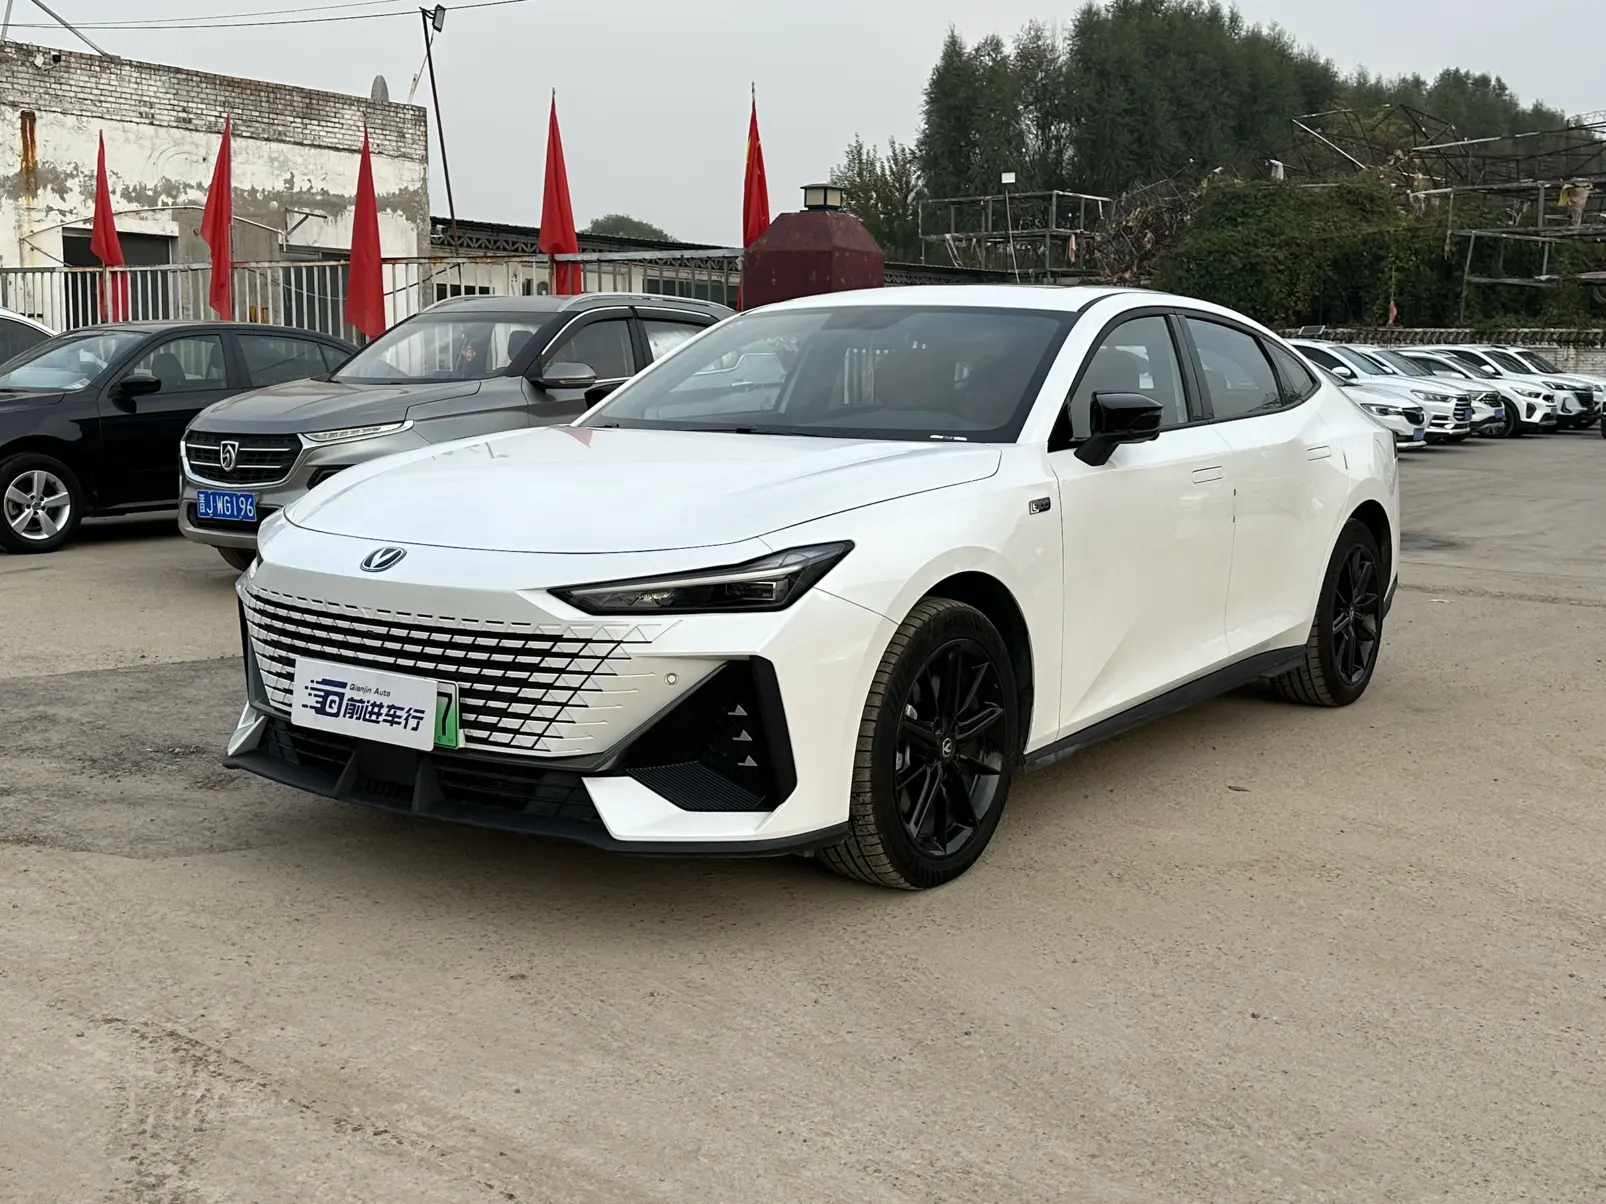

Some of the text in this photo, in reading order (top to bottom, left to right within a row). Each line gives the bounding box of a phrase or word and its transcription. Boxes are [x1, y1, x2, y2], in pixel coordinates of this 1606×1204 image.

[350, 684, 391, 697] Qianjin Auto
[343, 697, 426, 732] 前进车行
